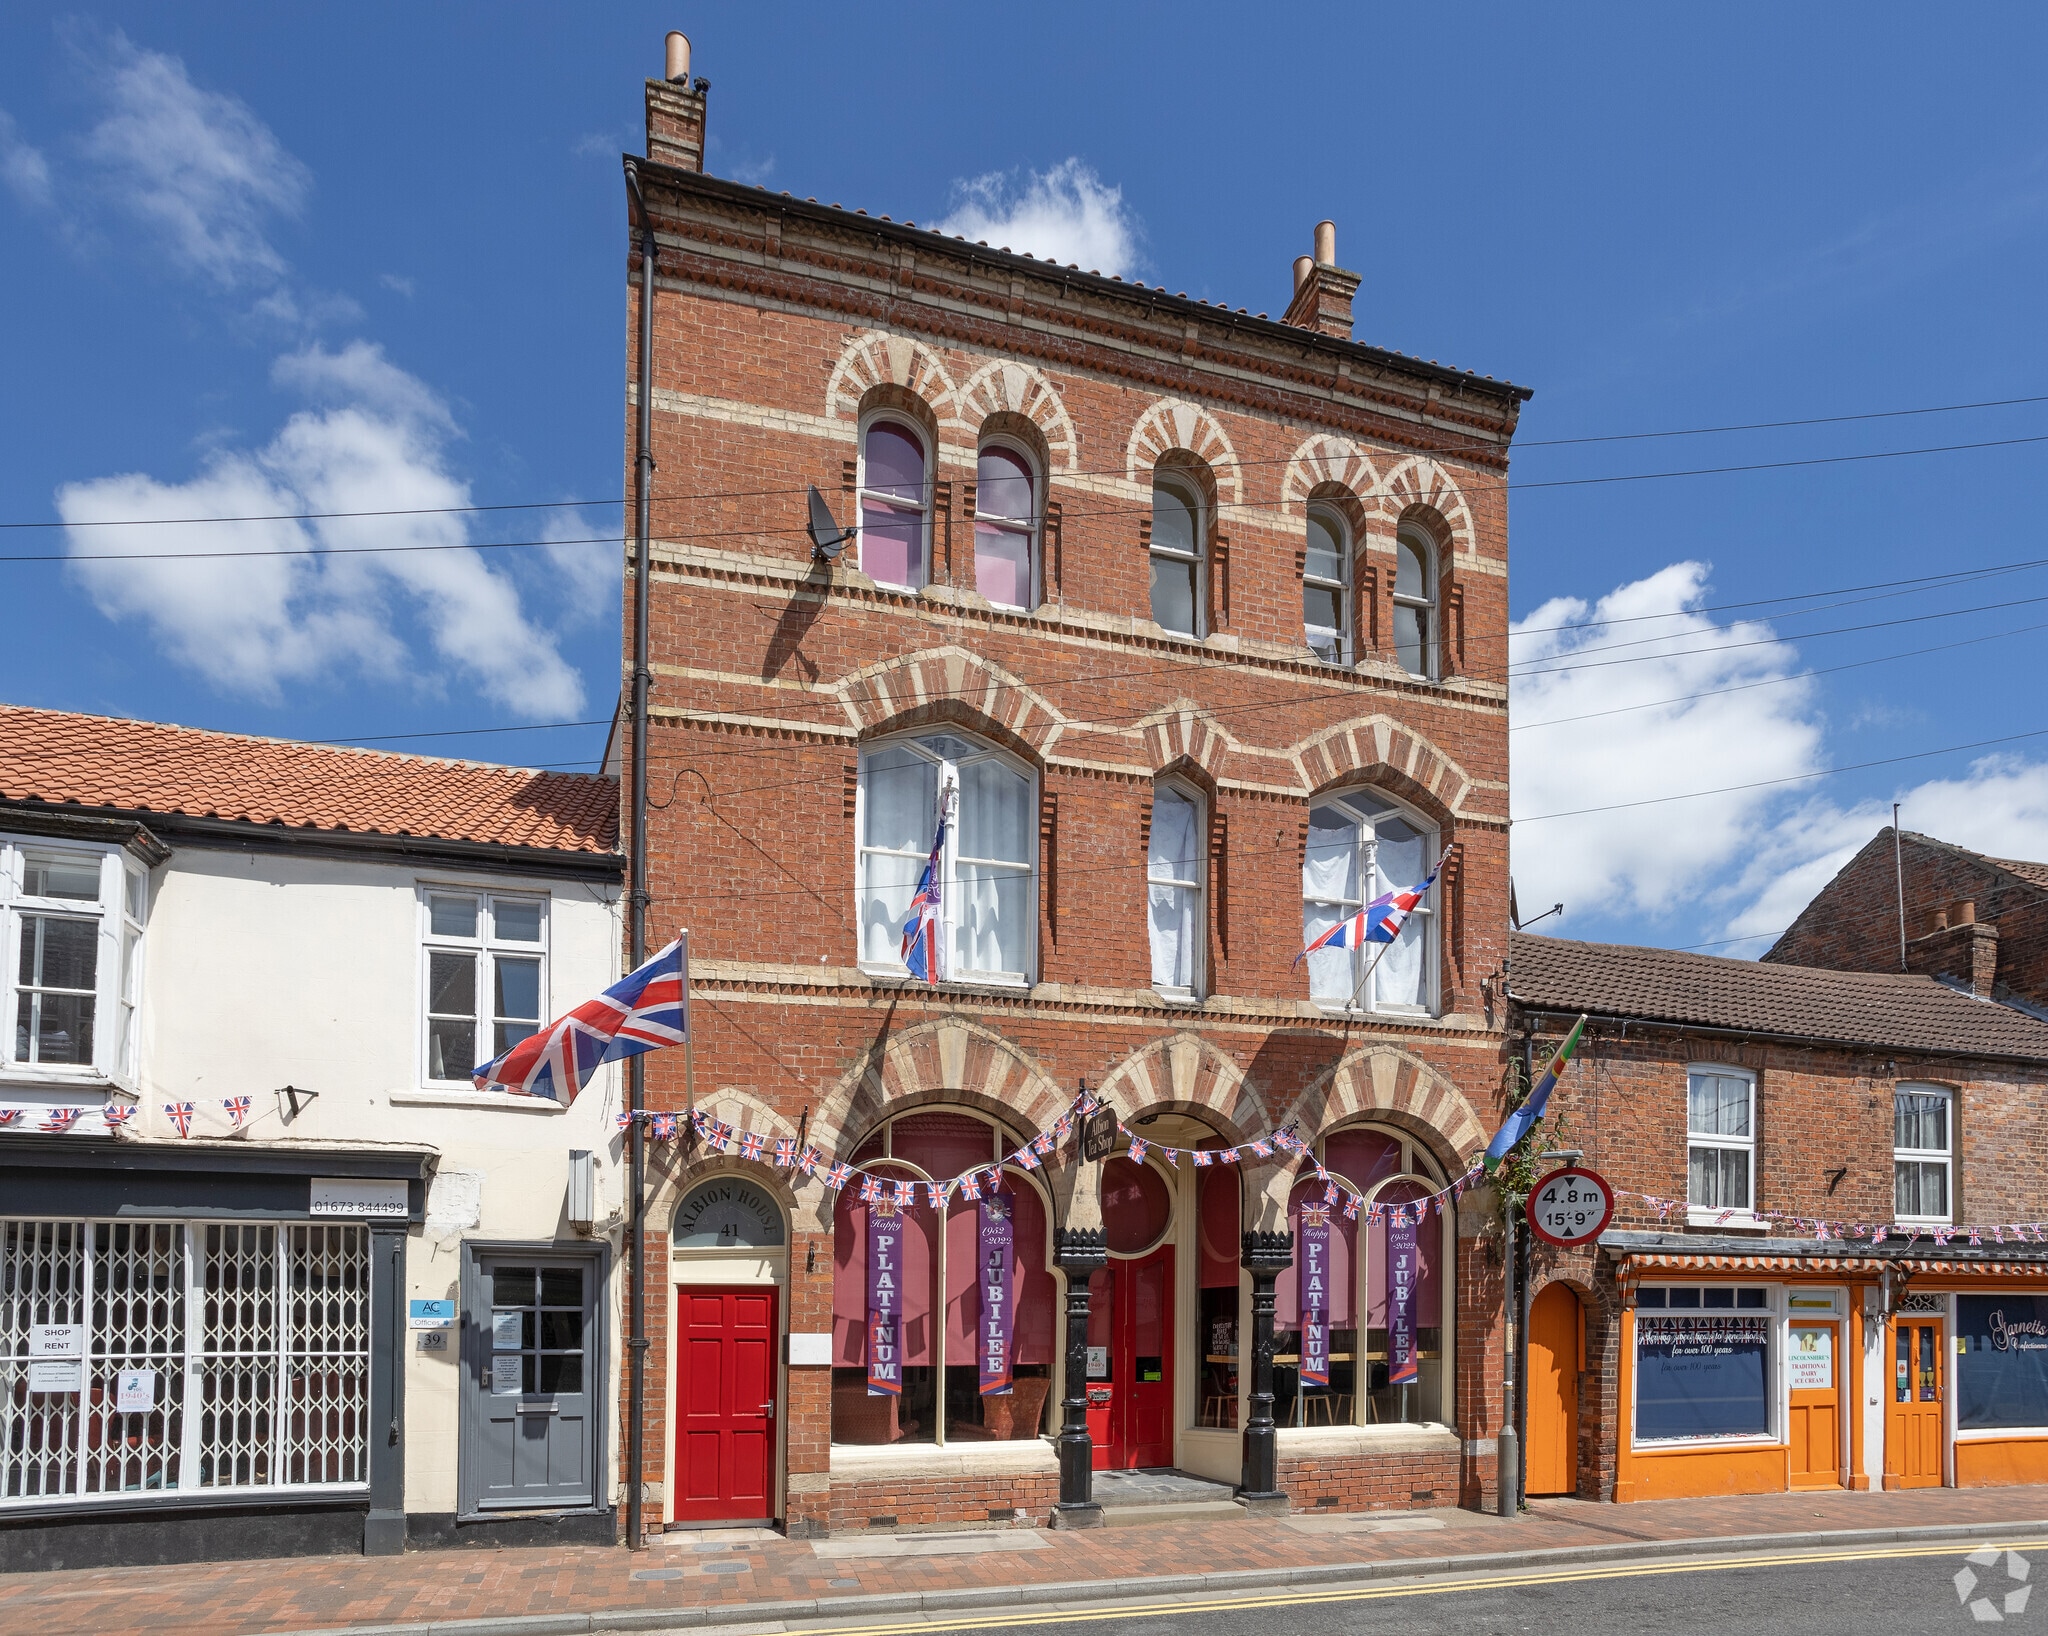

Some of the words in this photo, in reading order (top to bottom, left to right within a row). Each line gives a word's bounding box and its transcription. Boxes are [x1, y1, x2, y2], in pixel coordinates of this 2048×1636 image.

[1091, 1119, 1110, 1138] Albion
[1088, 1139, 1098, 1157] Tea
[1097, 1134, 1113, 1154] Shop
[1542, 1187, 1578, 1204] 4.8
[1583, 1192, 1598, 1203] m
[314, 1201, 354, 1213] 01673
[357, 1202, 404, 1214] 844499
[680, 1187, 731, 1233] ALBION
[738, 1188, 778, 1235] HOUSE
[720, 1223, 739, 1237] 41
[870, 1219, 902, 1231] Happy
[981, 1226, 1006, 1237] 1952
[1302, 1228, 1329, 1240] Happy
[1389, 1233, 1410, 1243] 1952
[873, 1235, 897, 1380] PLATINUM
[987, 1250, 1005, 1374] JUBILEE
[1304, 1243, 1325, 1372] PLATINUM
[1394, 1254, 1411, 1365] JUBILEE
[414, 1319, 441, 1327] Offices
[1989, 1309, 2048, 1351] Garnetts
[44, 1329, 71, 1337] SHOP
[424, 1333, 441, 1346] 39
[44, 1342, 71, 1350] RENT
[1671, 1345, 1684, 1358] for
[1700, 1344, 1713, 1354] 100
[1713, 1346, 1734, 1357] years
